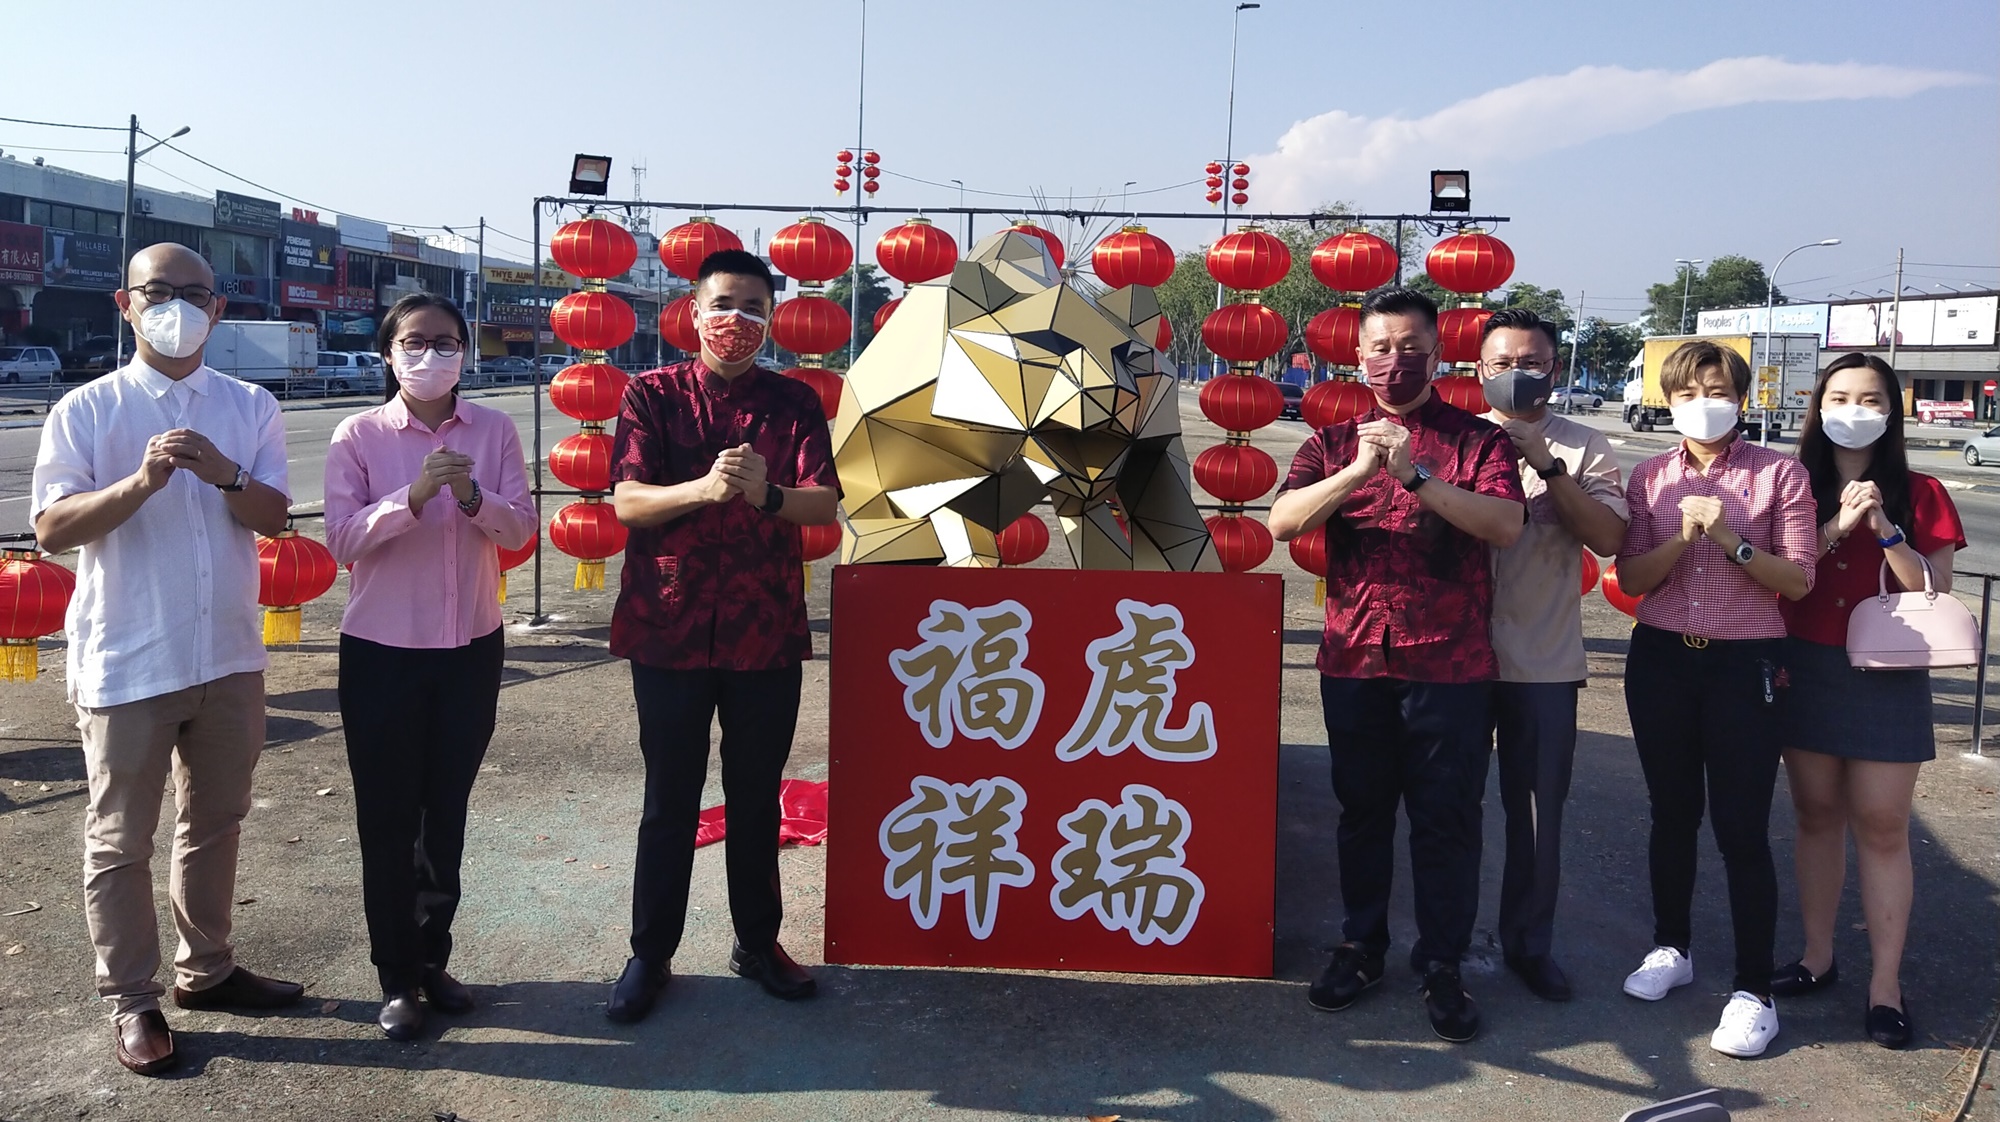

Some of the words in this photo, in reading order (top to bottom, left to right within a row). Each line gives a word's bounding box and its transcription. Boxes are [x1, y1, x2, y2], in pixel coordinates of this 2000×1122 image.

[292, 207, 319, 225] PAJAK
[75, 240, 111, 252] MILLABEL
[284, 245, 299, 256] PAJAK
[1, 249, 40, 268] 有限公司
[491, 270, 512, 279] THYE
